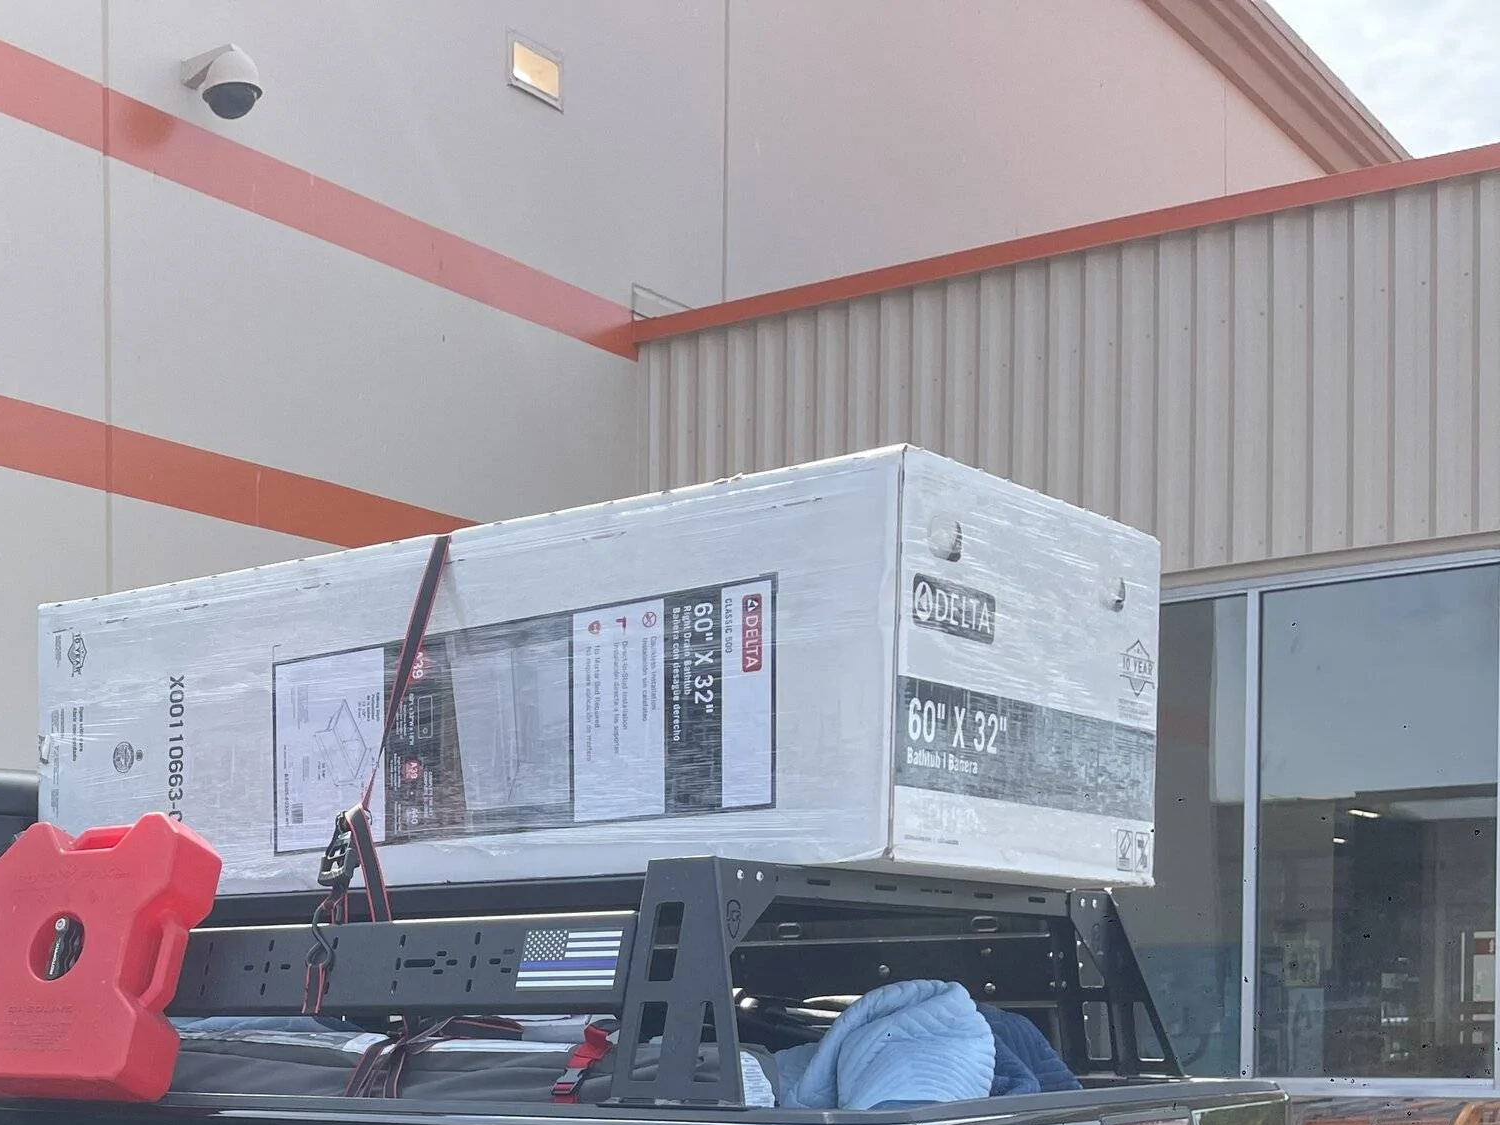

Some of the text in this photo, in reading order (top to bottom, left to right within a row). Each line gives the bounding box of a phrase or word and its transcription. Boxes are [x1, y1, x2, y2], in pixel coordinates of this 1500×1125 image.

[934, 588, 991, 634] DELTA
[694, 602, 714, 714] 60" X 32"
[745, 615, 759, 669] DELTA
[1123, 656, 1153, 676] 10 YEAR
[673, 704, 681, 741] derecho
[908, 697, 1007, 754] 60" X 32"
[906, 746, 941, 769] Bathtub
